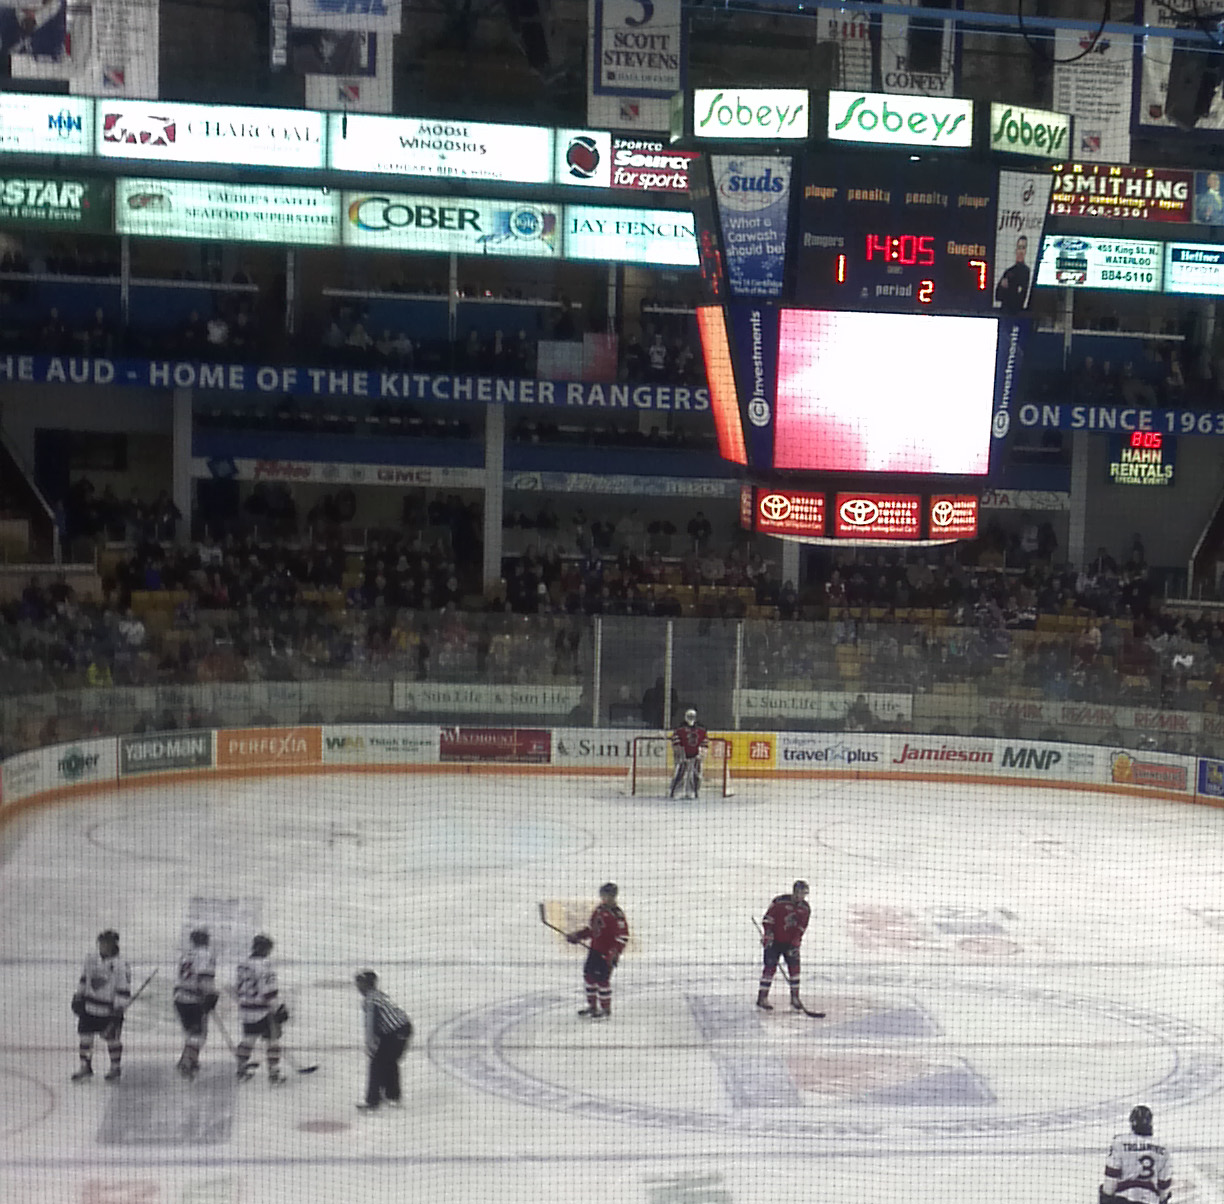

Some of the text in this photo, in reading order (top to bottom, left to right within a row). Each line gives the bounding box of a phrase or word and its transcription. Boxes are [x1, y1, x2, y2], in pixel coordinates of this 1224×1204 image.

[614, 32, 670, 50] SCOTT
[604, 50, 678, 70] STEVENS
[700, 92, 804, 132] Sobeys
[834, 96, 967, 140] Sobeys
[418, 123, 470, 138] MOOSE
[992, 109, 1069, 151] Sobeys
[613, 167, 688, 190] for sports
[727, 168, 784, 194] suds
[184, 206, 339, 227] SEAFOOD SUPERSTORE
[348, 196, 483, 232] COBER
[570, 218, 606, 235] JAY
[866, 234, 936, 266] 14:05
[1105, 256, 1151, 266] WATERLOO
[1115, 245, 1134, 256] King
[836, 254, 987, 291] 1 7
[875, 279, 935, 303] period 2
[46, 359, 115, 384] AUD
[149, 363, 245, 391] HOME
[256, 367, 298, 393] OF
[307, 369, 369, 397] THE
[379, 373, 556, 405] KITCHENER
[566, 382, 710, 411] RANGERS
[1019, 403, 1062, 427] ON
[1072, 407, 1154, 432] SINCE
[1121, 448, 1162, 464] HAHN
[1110, 462, 1173, 478] RENTALS
[759, 697, 788, 709] Sun
[228, 733, 308, 757] PERFEXIA
[579, 740, 620, 757] Sun
[783, 747, 878, 765] travel plus
[893, 743, 994, 764] Jamieson
[1001, 746, 1062, 771] MNP
[1138, 1155, 1155, 1180] 3
